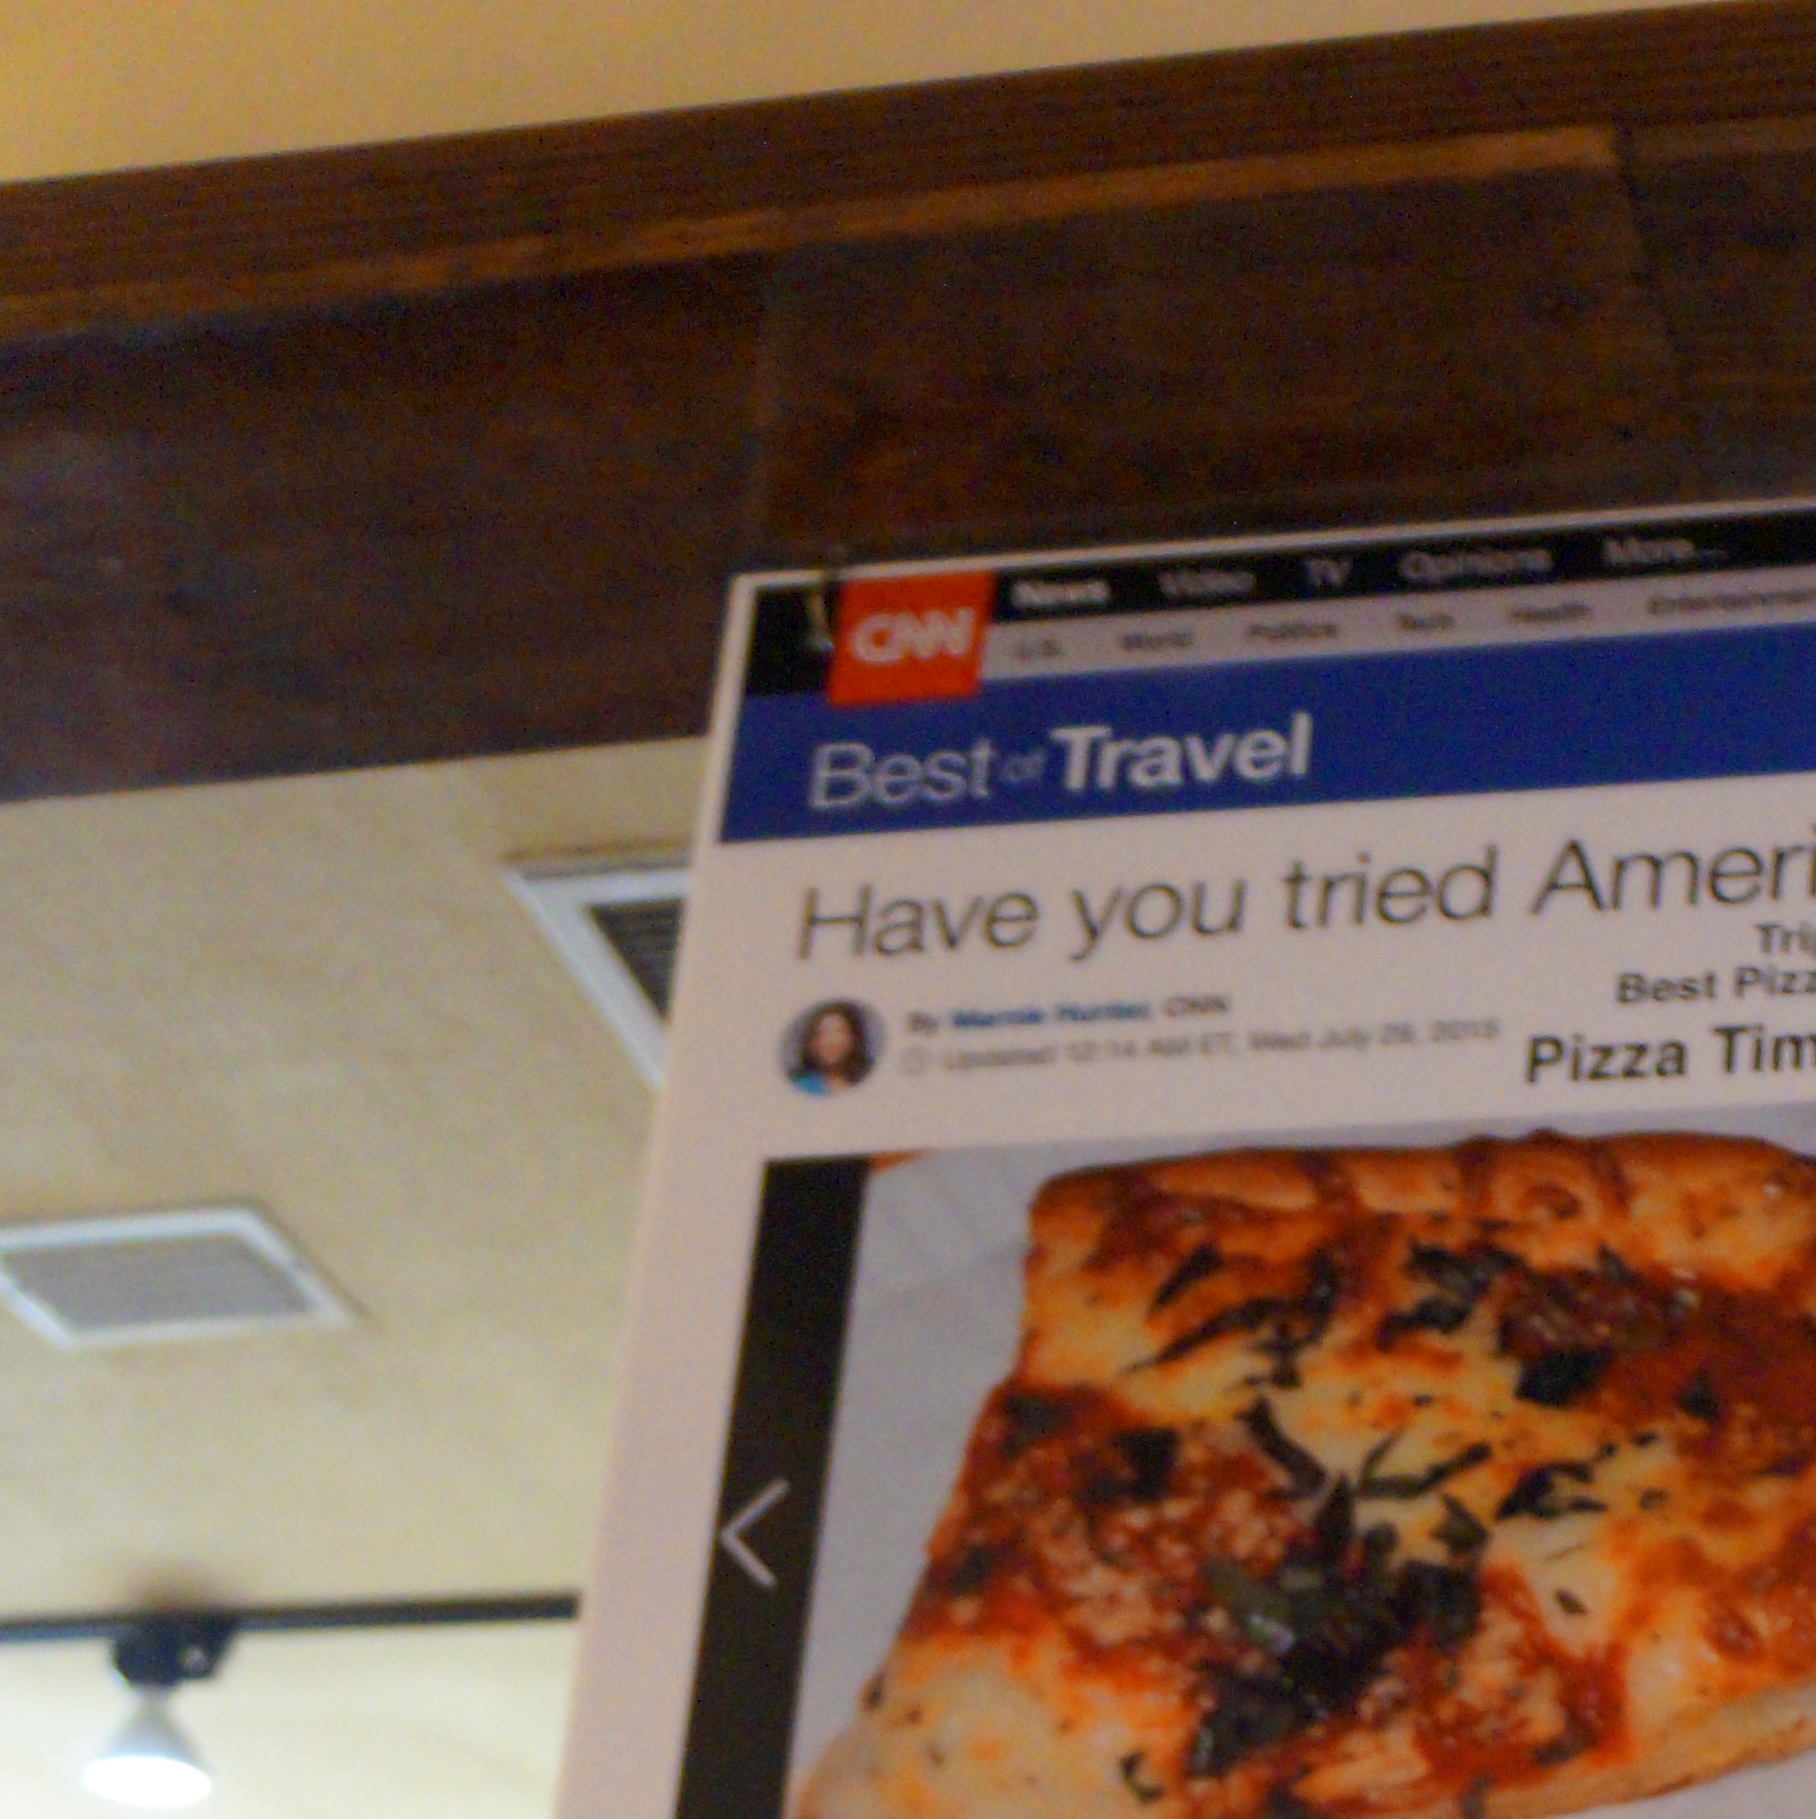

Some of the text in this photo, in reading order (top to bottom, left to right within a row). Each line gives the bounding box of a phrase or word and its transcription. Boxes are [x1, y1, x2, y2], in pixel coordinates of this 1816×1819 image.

[1012, 578, 1111, 607] News
[1305, 557, 1353, 588] TV
[849, 606, 978, 665] CNN
[808, 739, 996, 812] Best
[1051, 712, 1312, 792] Travel
[797, 884, 1040, 960] Have
[1069, 879, 1247, 964] you
[1282, 845, 1499, 932] tried
[1615, 971, 1718, 1006] Best
[1525, 1035, 1688, 1085] Pizza
